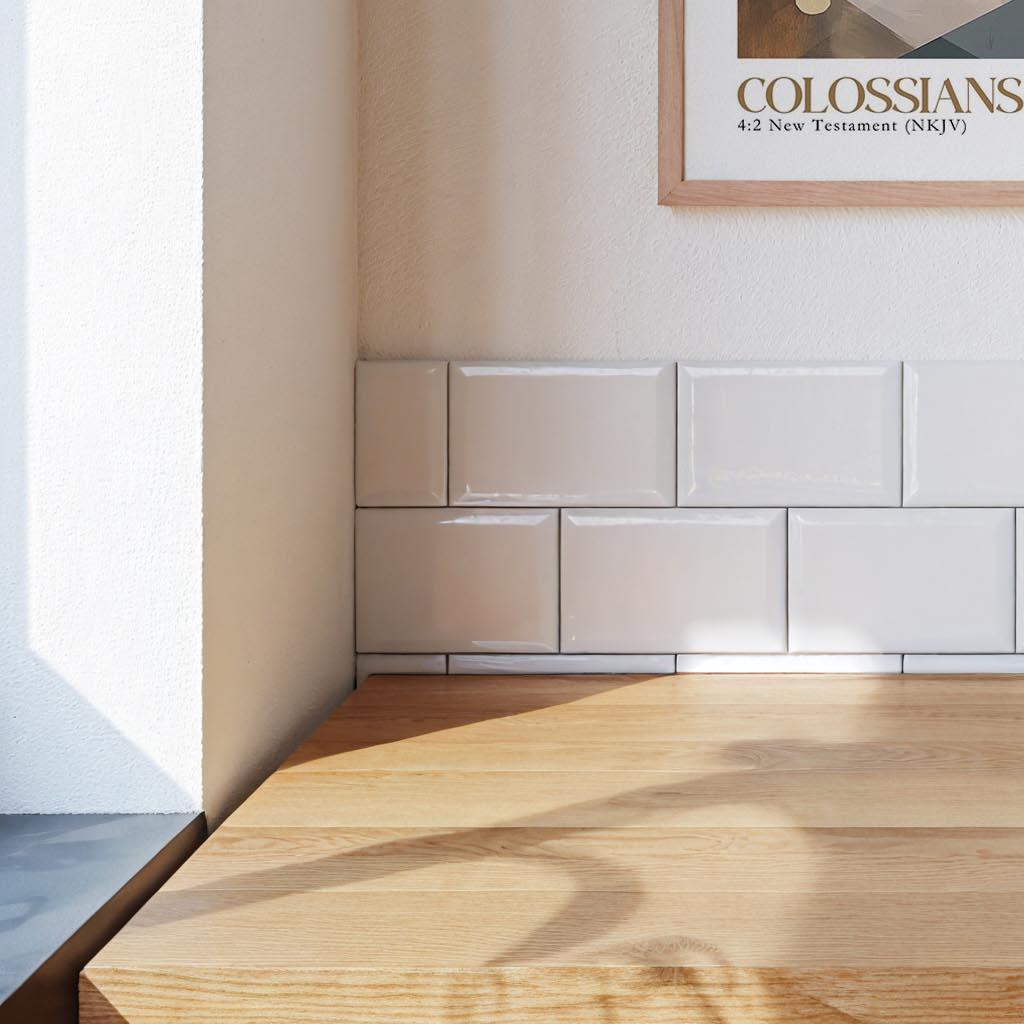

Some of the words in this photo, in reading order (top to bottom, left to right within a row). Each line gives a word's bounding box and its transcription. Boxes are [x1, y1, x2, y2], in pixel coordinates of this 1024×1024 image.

[737, 76, 1024, 114] COLOSSIANS
[737, 119, 761, 132] 4:2
[769, 119, 805, 132] New
[812, 119, 898, 132] Testament
[905, 119, 967, 136] (NKJV)
